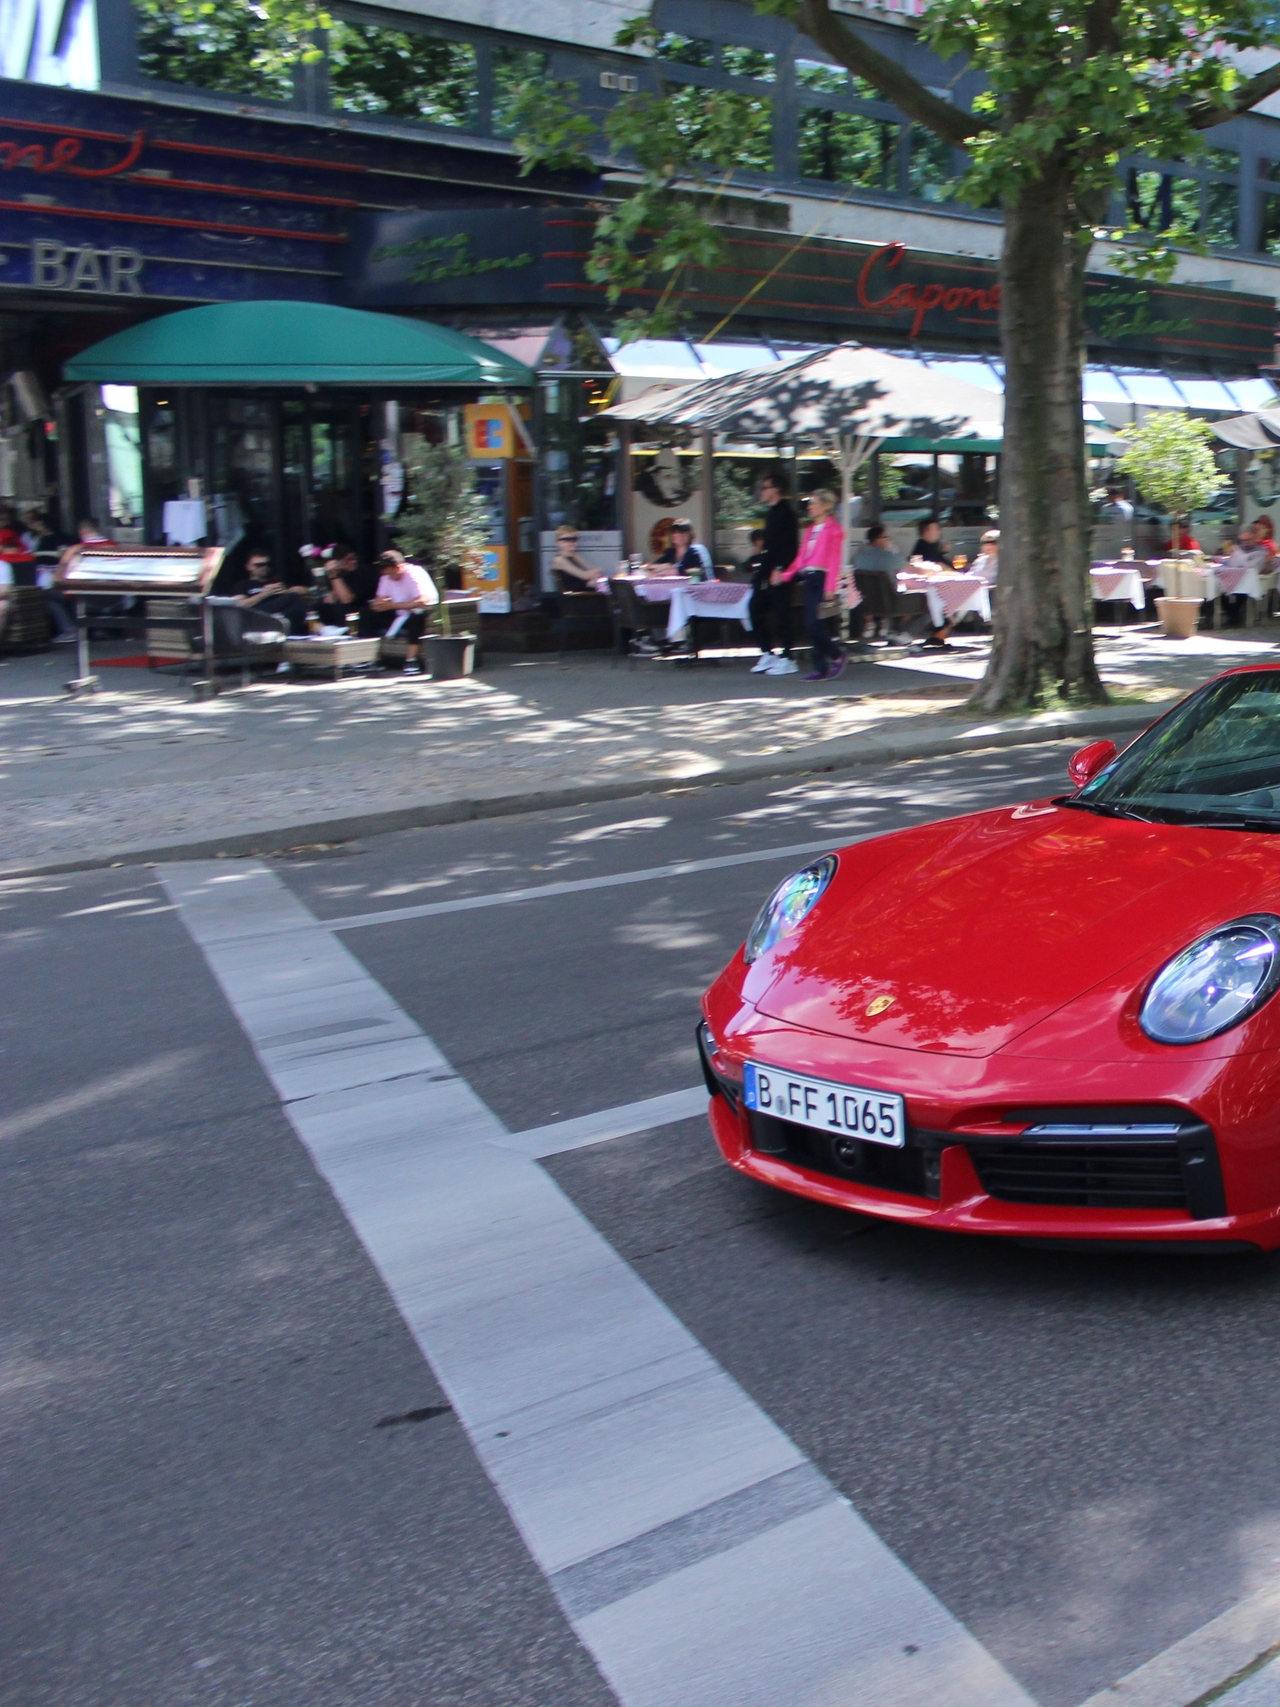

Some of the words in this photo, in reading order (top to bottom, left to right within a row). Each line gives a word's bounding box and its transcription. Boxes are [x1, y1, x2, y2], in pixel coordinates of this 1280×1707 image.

[33, 239, 144, 297] BAR
[758, 1073, 772, 1108] B
[788, 1082, 818, 1120] FF
[825, 1092, 895, 1138] 1065
